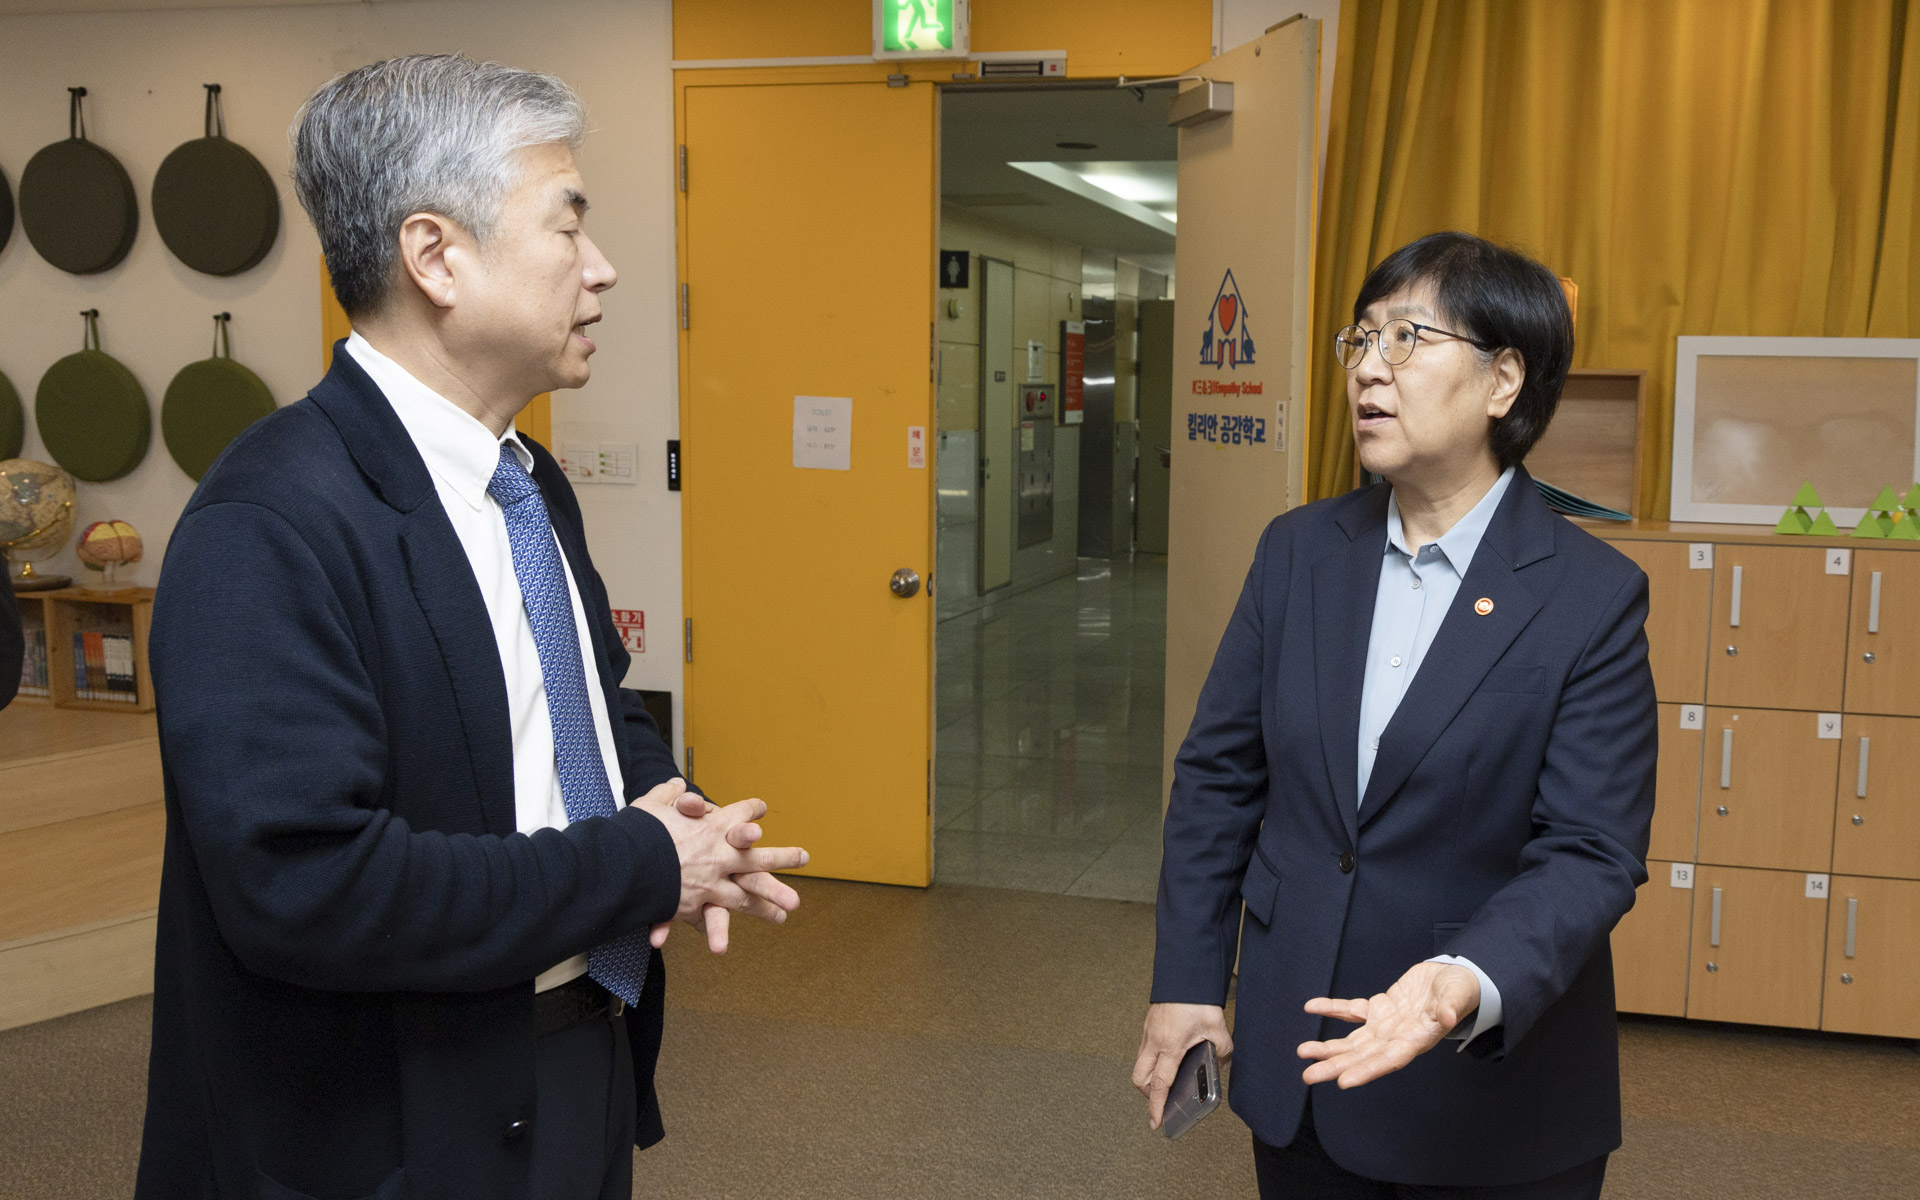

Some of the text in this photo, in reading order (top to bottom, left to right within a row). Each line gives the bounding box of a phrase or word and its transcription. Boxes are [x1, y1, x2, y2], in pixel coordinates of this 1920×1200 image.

[1241, 381, 1263, 395] School
[1188, 413, 1218, 442] 킬리안
[1220, 414, 1266, 446] 공감학교
[1697, 550, 1705, 561] 3
[1833, 556, 1842, 566] 4
[1687, 712, 1696, 722] 8
[1825, 721, 1834, 731] 9
[1676, 870, 1689, 881] 13
[1811, 880, 1823, 891] 14
